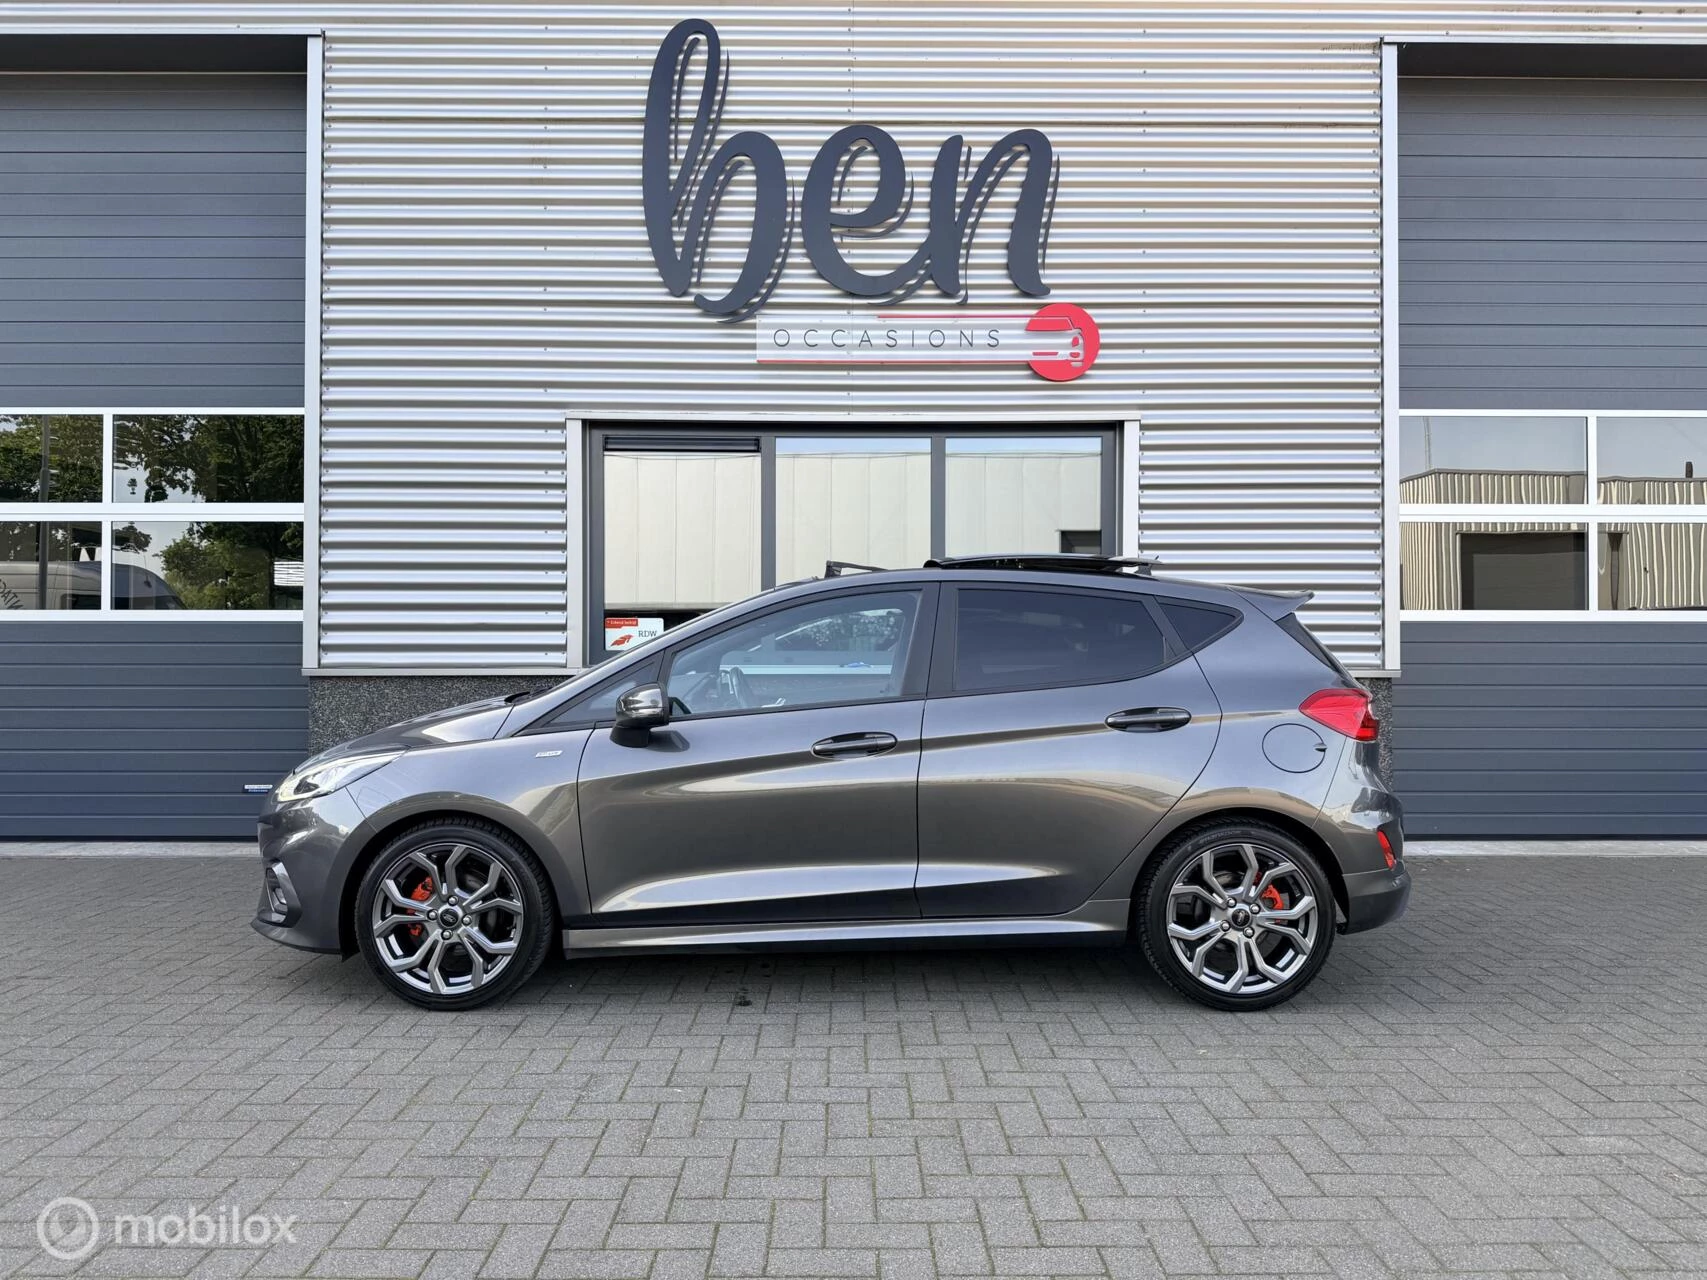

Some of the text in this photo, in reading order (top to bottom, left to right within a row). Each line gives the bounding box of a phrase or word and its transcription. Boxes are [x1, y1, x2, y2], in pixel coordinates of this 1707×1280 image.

[642, 18, 1053, 314] ben
[773, 328, 1000, 348] OCCASIONS
[638, 630, 658, 638] RDW
